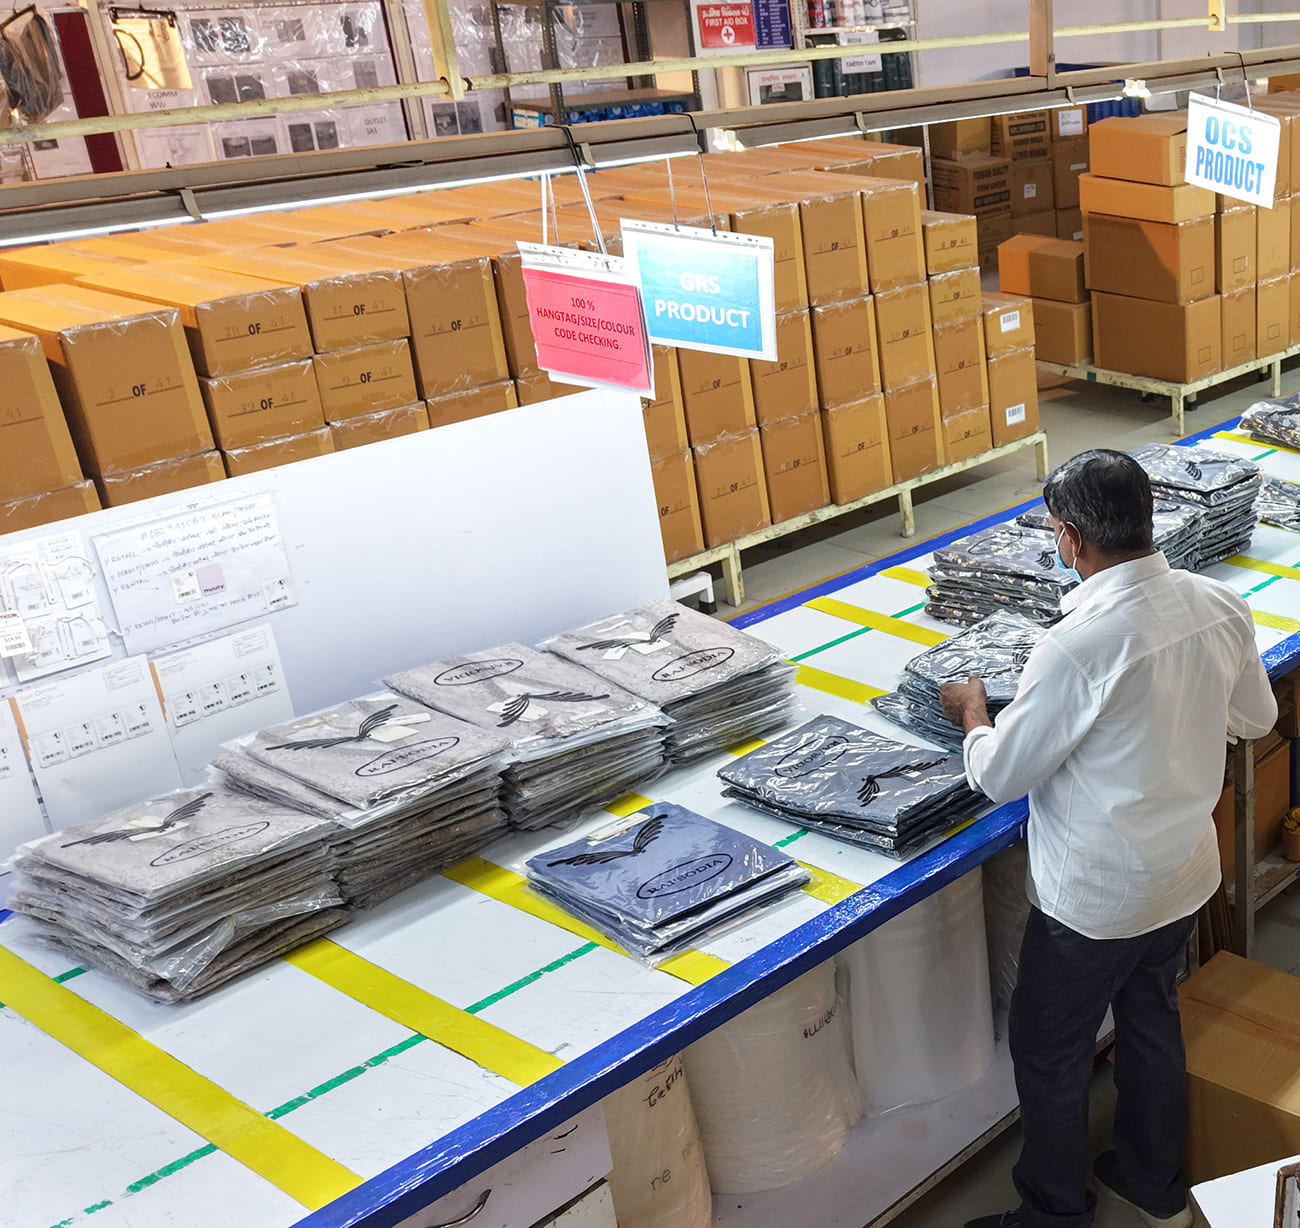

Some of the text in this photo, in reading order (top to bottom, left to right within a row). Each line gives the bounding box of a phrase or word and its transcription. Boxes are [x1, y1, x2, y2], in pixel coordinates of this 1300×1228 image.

[705, 17, 748, 26] FIRST AID BOX
[1205, 116, 1253, 155] OCS
[1195, 145, 1265, 195] PRODUCT
[680, 272, 721, 294] GRS
[353, 304, 366, 316] OF
[570, 297, 595, 311] 100 %
[654, 300, 751, 329] PRODUCT
[451, 320, 462, 332] OF
[536, 307, 636, 337] HANGTAG/SIZE/COLOUR
[248, 323, 262, 336] OF
[554, 326, 622, 350] CODE CHECKING.
[360, 372, 372, 384] OF
[132, 384, 147, 398] OF
[260, 398, 275, 411] OF
[661, 505, 670, 516] OF
[646, 859, 724, 894] RAPSODIA
